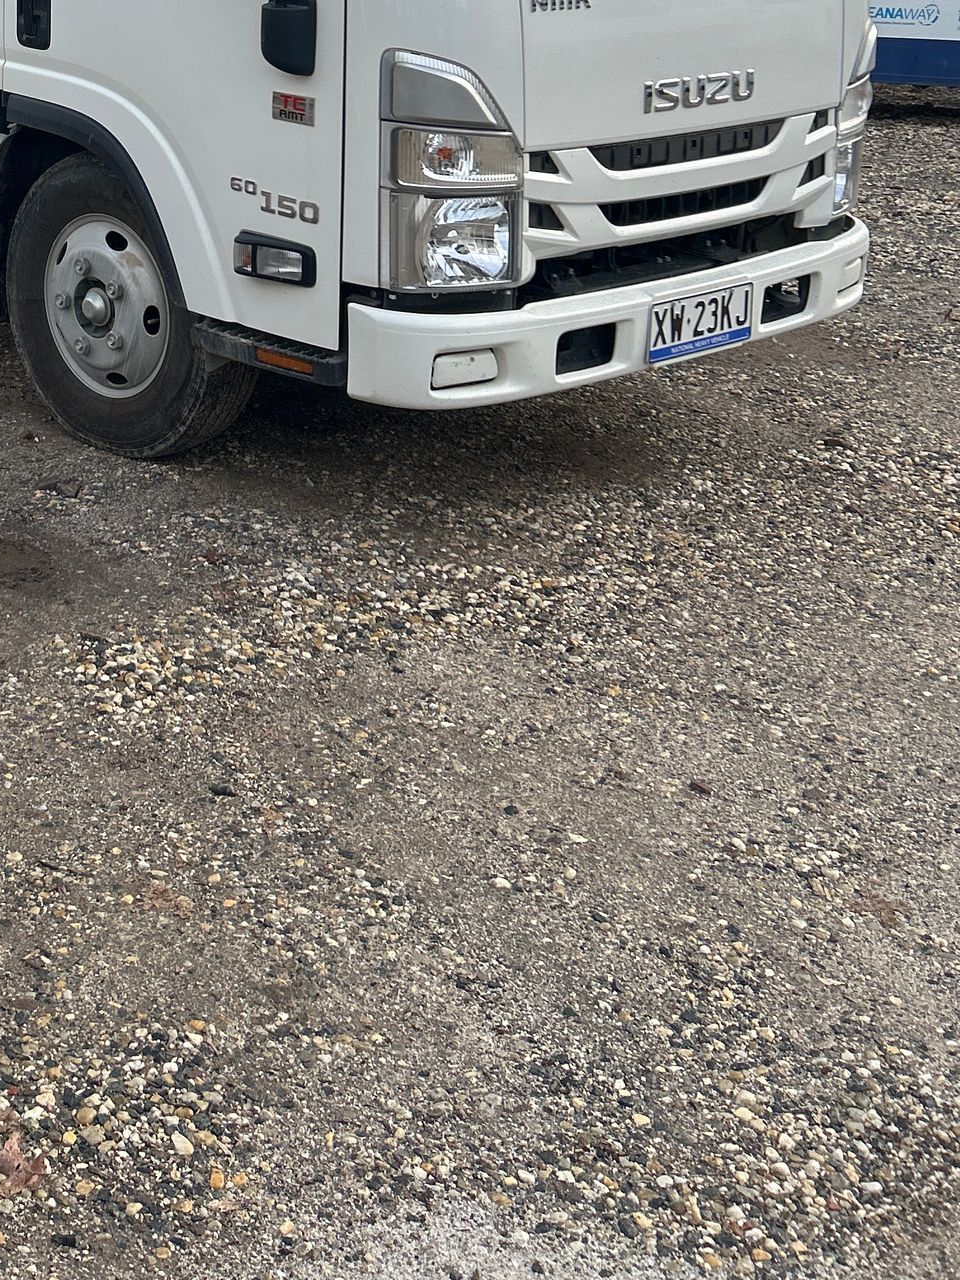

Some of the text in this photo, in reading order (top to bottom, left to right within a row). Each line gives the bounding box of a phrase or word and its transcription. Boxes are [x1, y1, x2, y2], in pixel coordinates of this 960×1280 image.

[644, 69, 755, 114] ISUZU
[279, 95, 306, 112] TE
[279, 109, 306, 122] AMT
[230, 176, 257, 195] 60
[260, 190, 320, 224] 150
